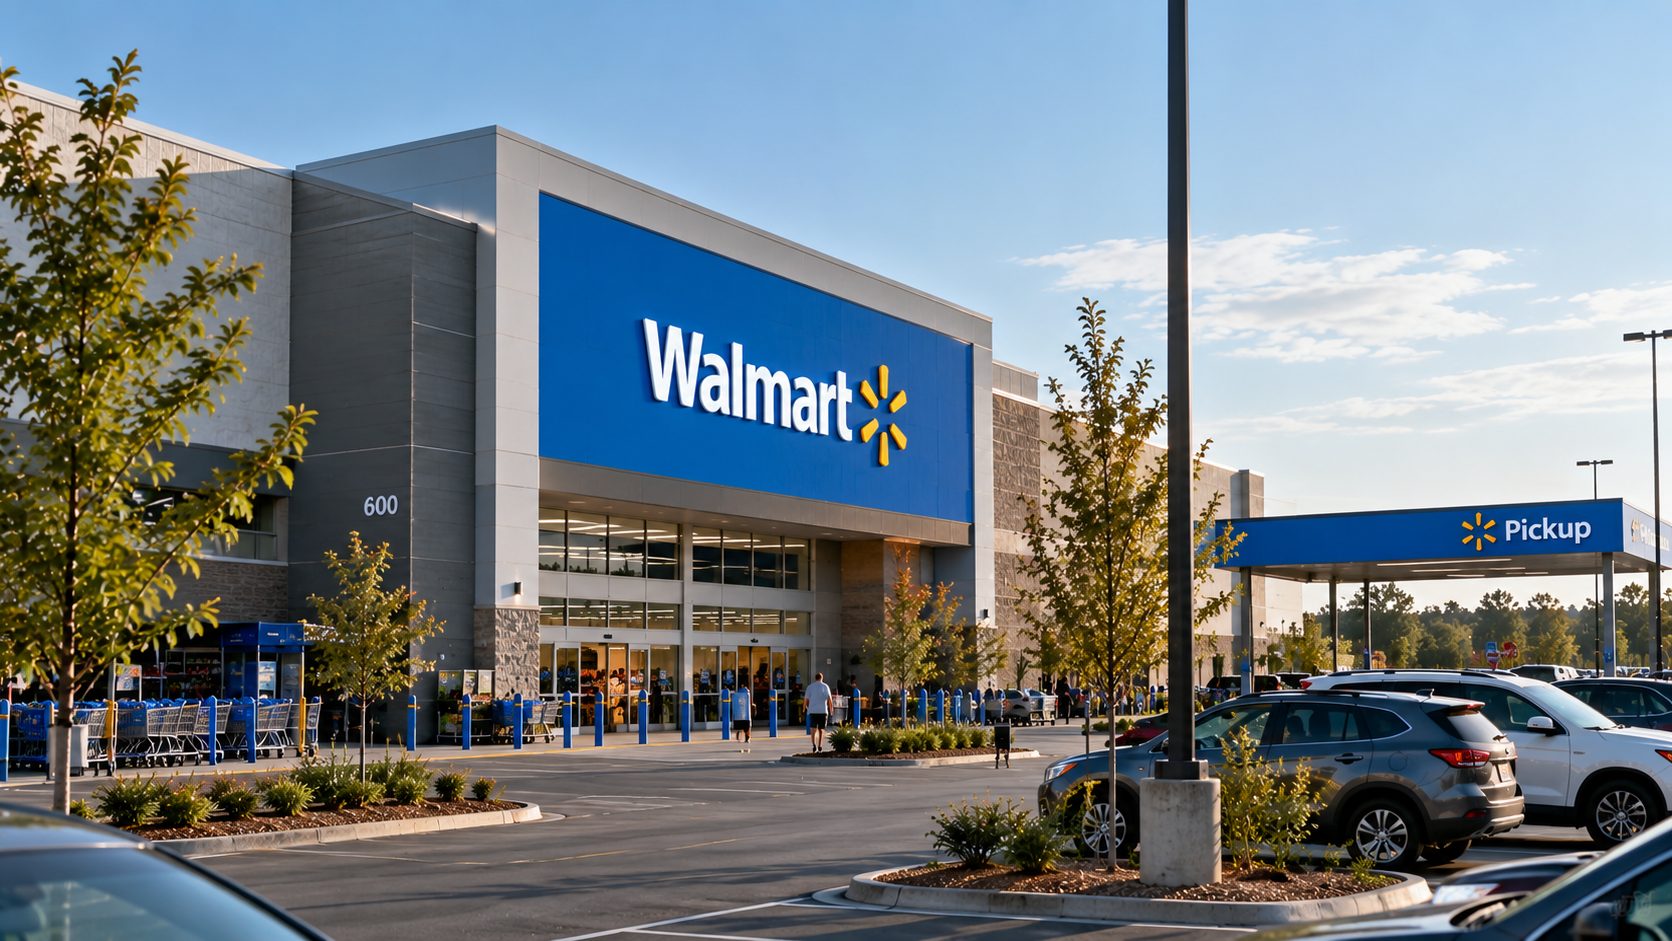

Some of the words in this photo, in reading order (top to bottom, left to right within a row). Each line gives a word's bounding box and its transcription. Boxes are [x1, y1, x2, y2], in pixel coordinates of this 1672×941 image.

[643, 318, 853, 441] Walmart
[364, 495, 398, 516] 600
[1505, 517, 1592, 544] Pickup
